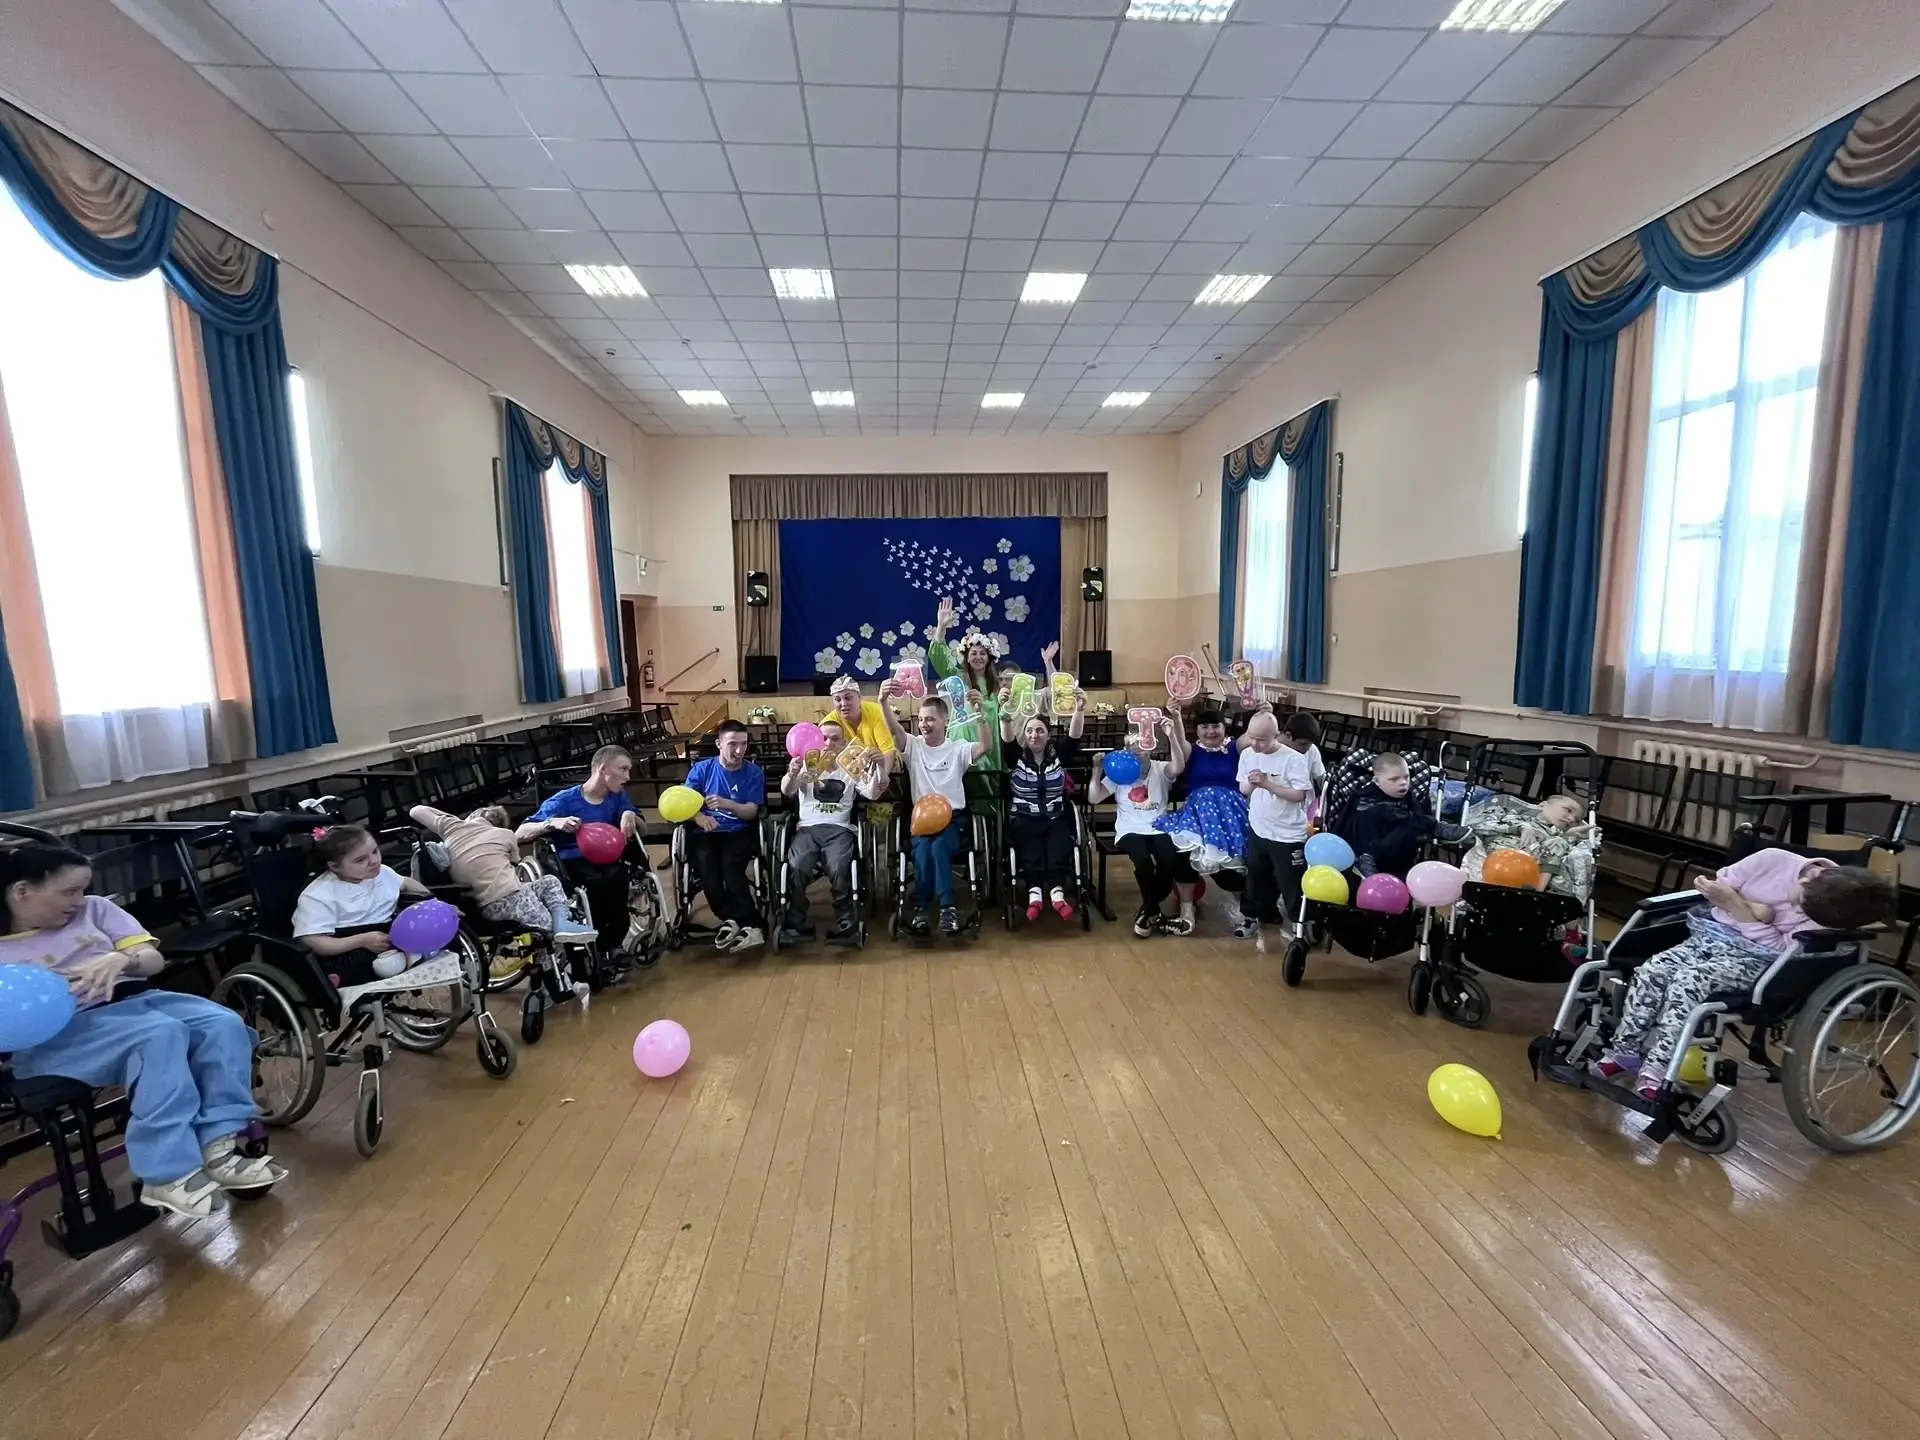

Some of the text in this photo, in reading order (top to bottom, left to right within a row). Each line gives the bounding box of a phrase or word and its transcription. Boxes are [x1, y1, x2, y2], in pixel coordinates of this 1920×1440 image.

[889, 660, 928, 699] А
[1003, 673, 1038, 717] Л
[1051, 672, 1079, 716] Е
[1127, 707, 1163, 750] Т
[1164, 655, 1201, 700] О
